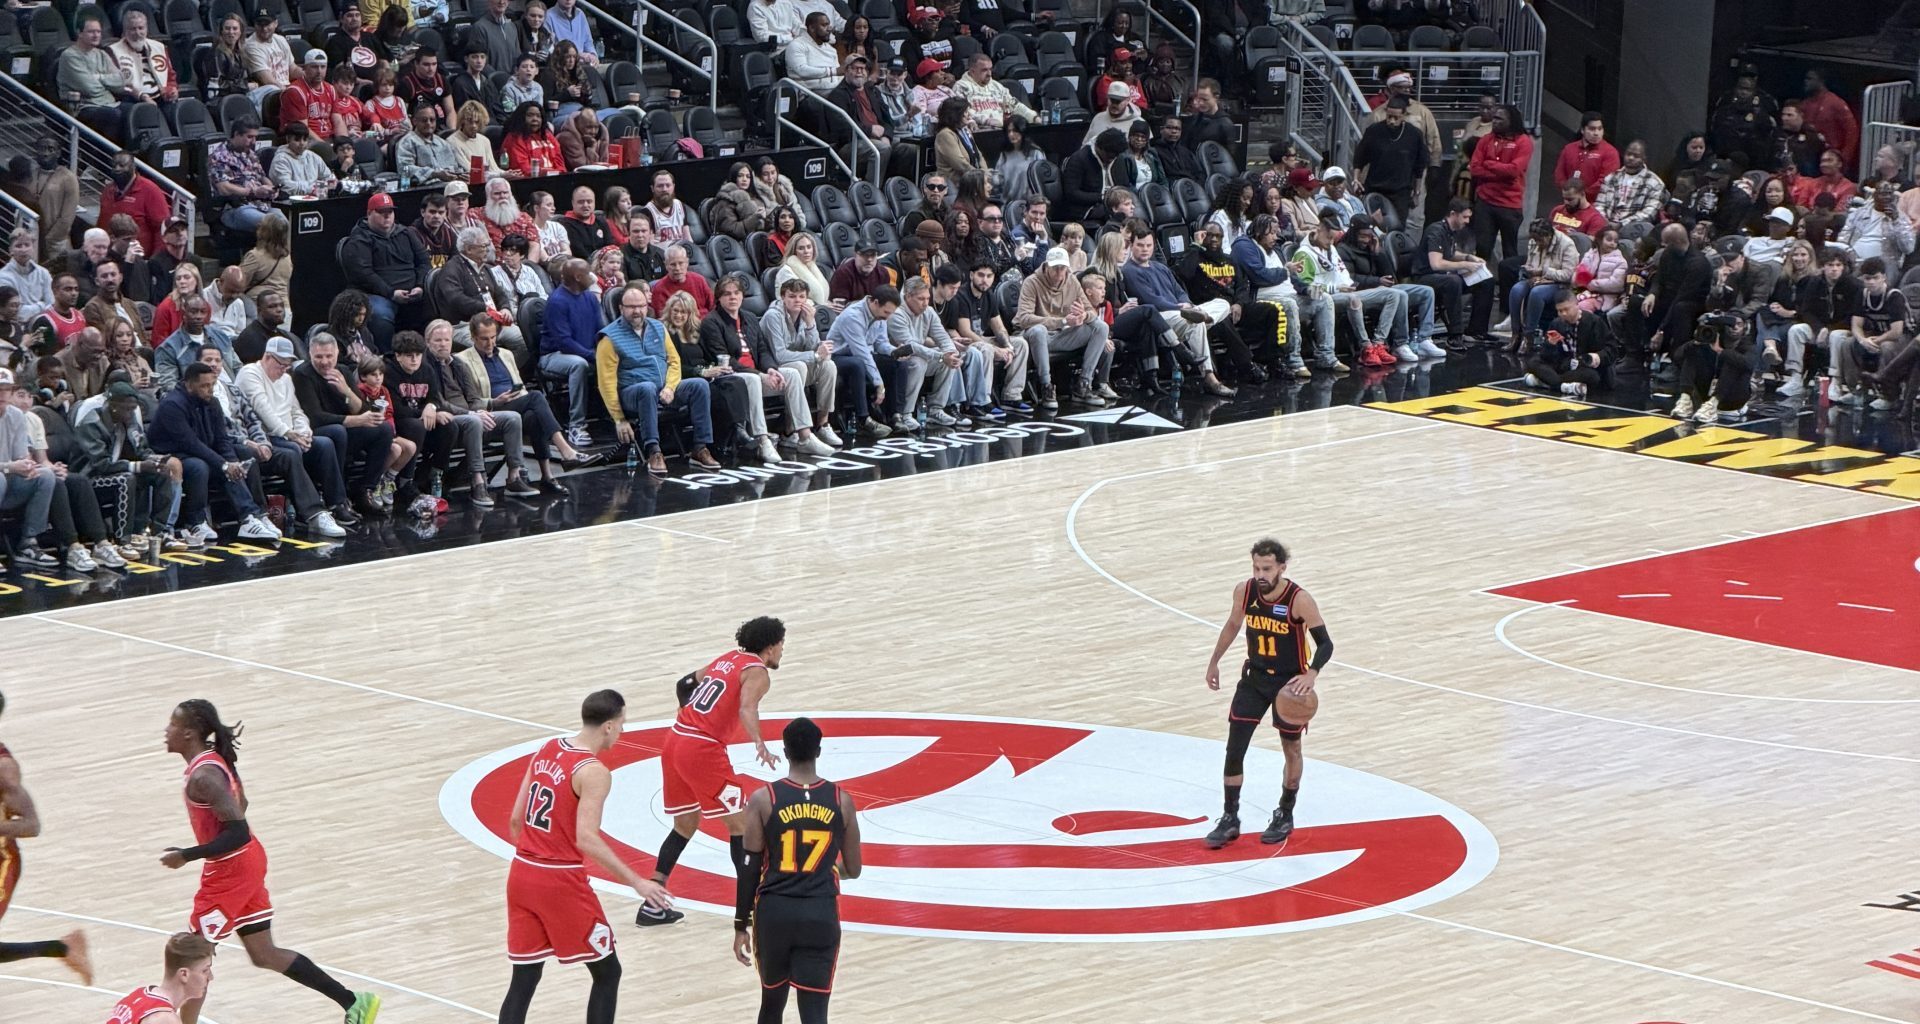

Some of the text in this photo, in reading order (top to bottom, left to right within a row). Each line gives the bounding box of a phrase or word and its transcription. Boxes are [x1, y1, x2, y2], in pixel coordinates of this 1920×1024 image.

[808, 163, 822, 174] 109
[302, 216, 320, 228] 109
[664, 421, 1086, 491] Georgia Power
[1246, 614, 1290, 635] HAWKS
[1257, 634, 1277, 657] 11
[533, 759, 566, 786] COLLINS
[525, 780, 555, 833] 12
[778, 803, 836, 825] OKONGWU
[779, 829, 833, 873] 17
